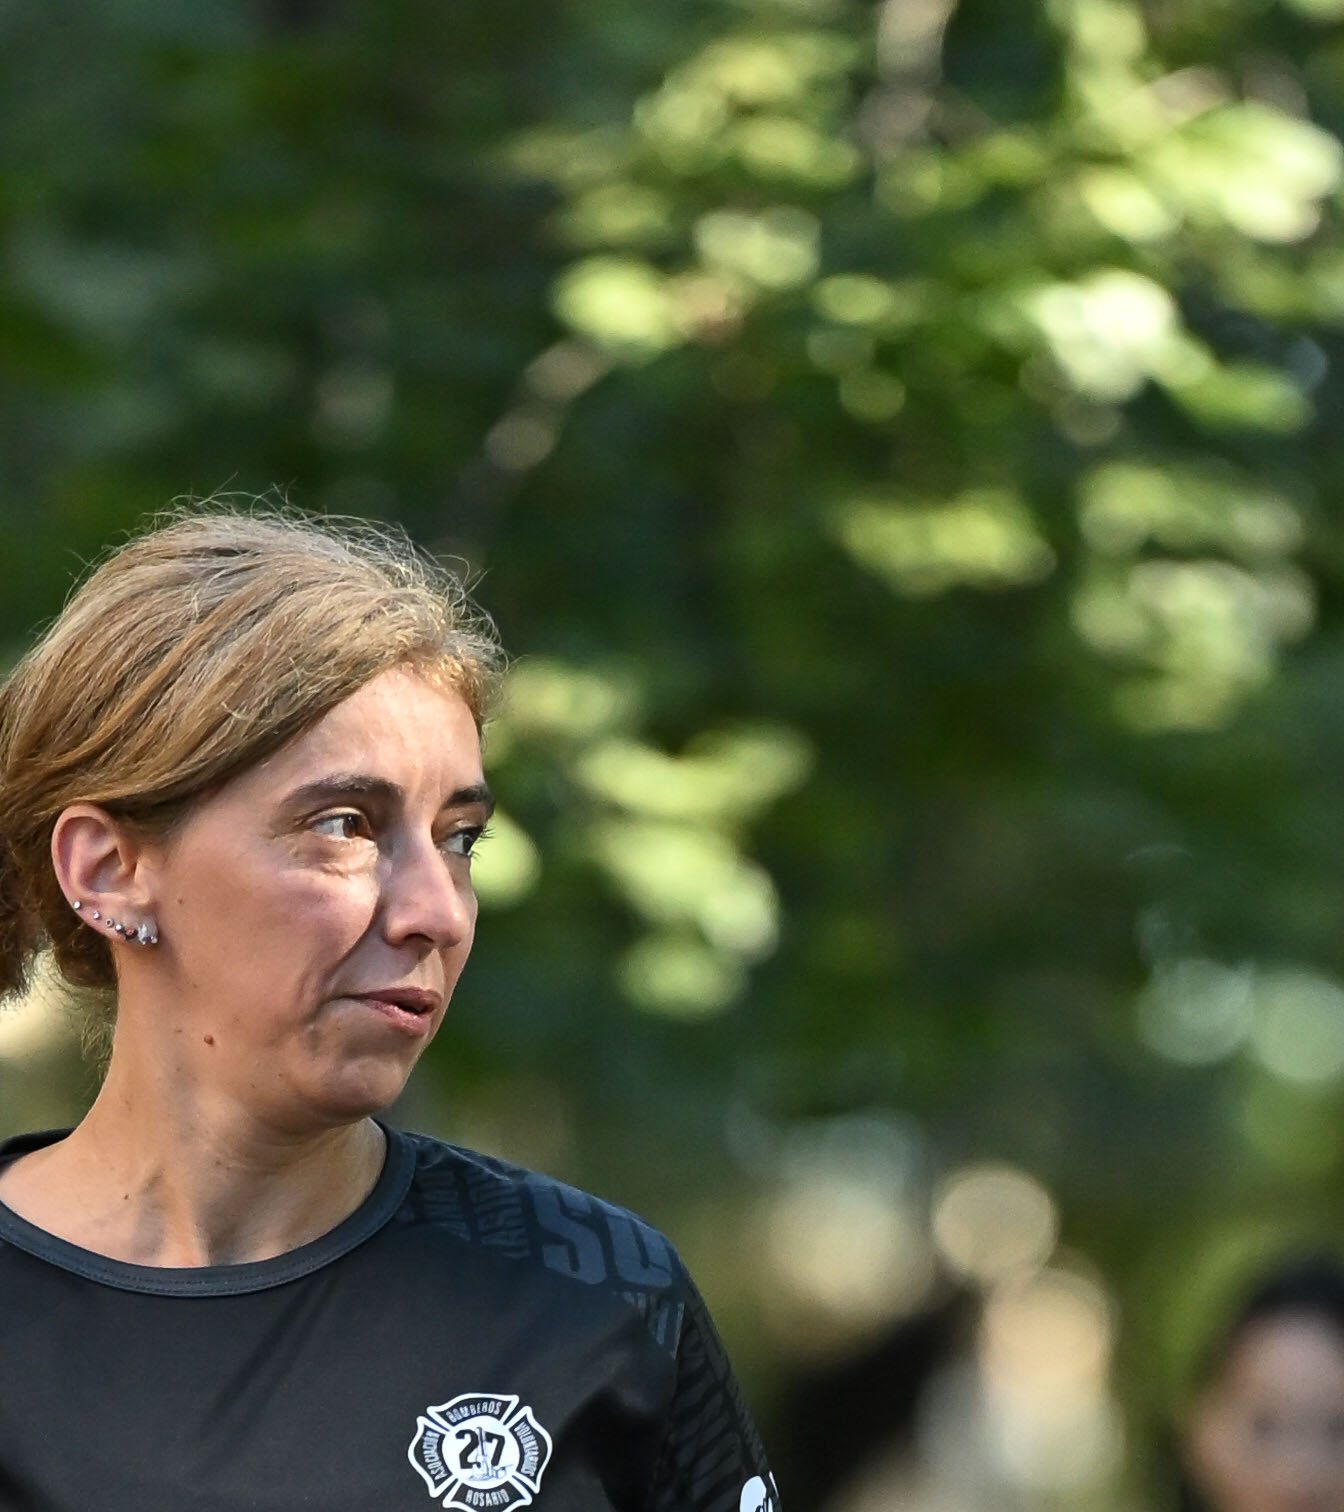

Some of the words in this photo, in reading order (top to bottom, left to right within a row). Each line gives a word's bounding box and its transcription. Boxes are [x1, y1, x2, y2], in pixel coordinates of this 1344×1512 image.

[445, 1400, 503, 1423] BOMBEROS
[455, 1428, 506, 1469] 27
[465, 1488, 510, 1507] ROSARIO
